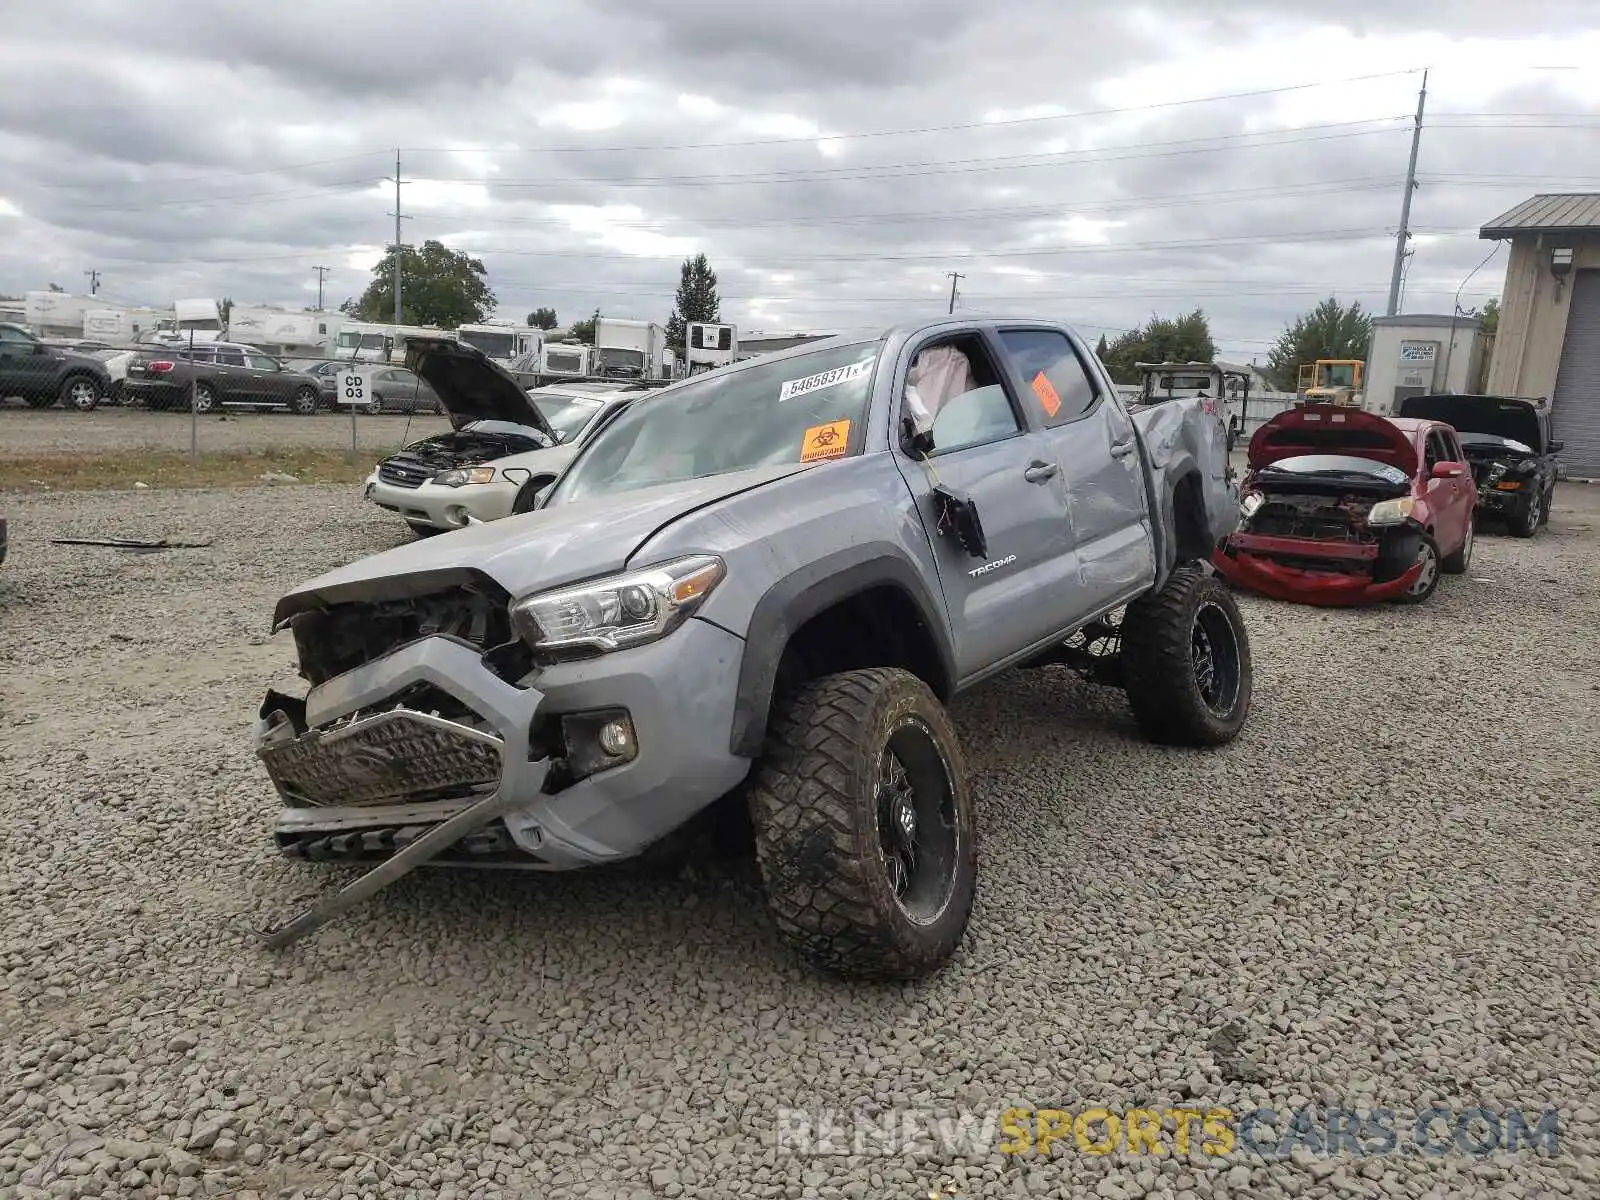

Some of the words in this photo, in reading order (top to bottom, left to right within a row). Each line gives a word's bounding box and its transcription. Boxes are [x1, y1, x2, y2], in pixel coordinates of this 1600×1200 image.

[345, 375, 363, 387] CD
[345, 388, 363, 399] 03
[968, 554, 1017, 577] TACOMA
